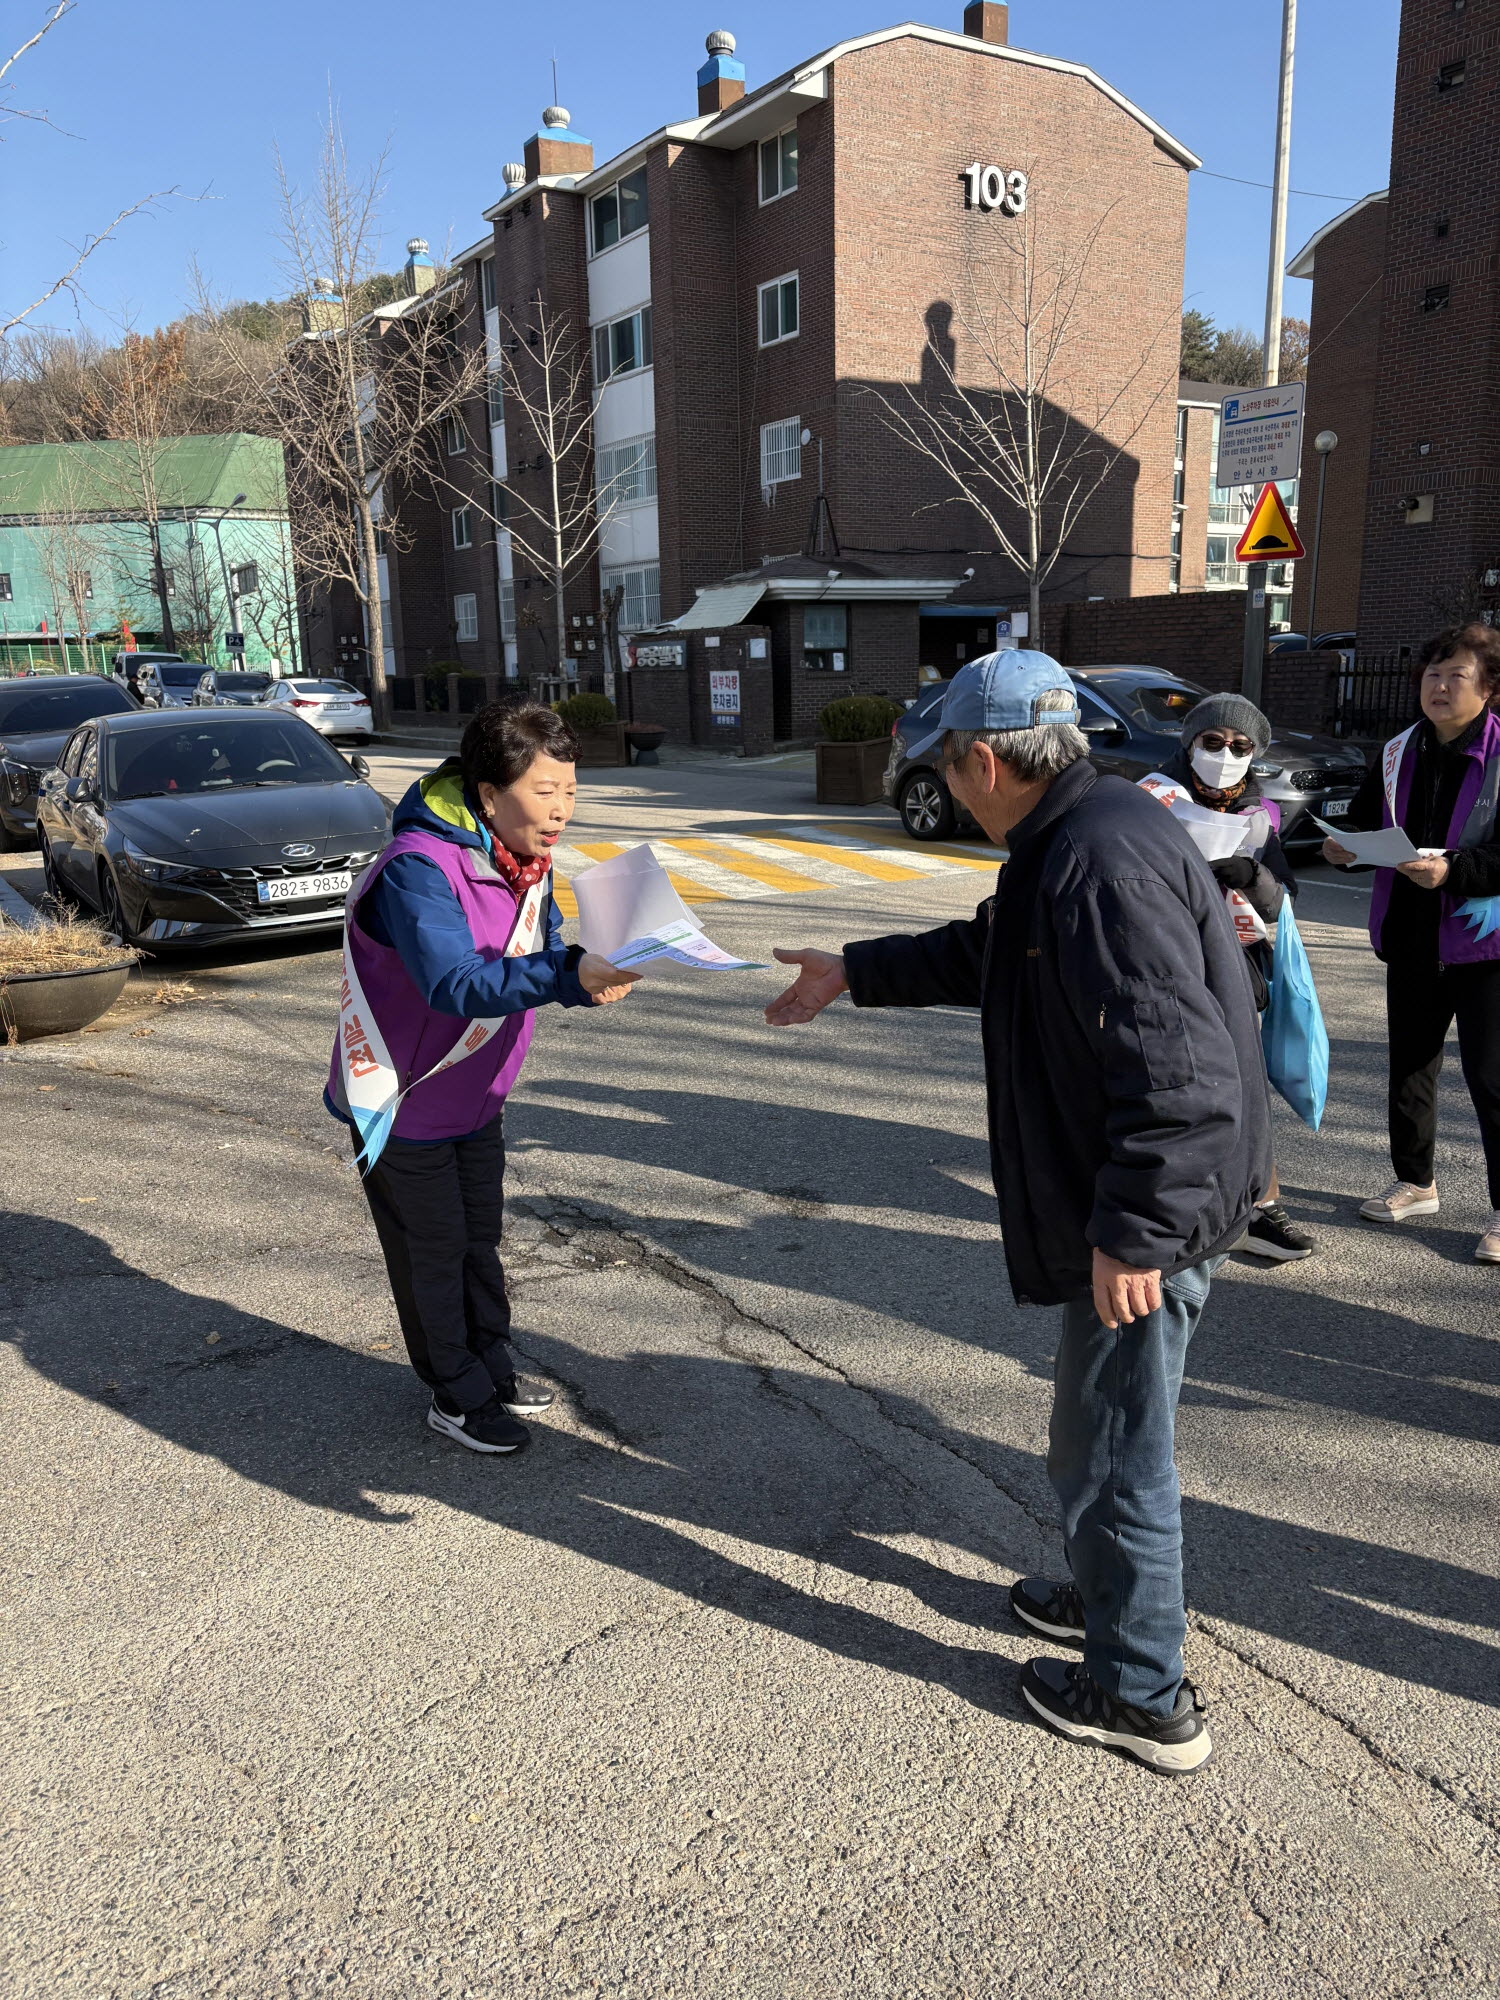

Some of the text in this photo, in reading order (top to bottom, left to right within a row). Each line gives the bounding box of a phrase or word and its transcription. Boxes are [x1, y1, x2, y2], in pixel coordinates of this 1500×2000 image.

[965, 162, 1028, 213] 103
[228, 636, 235, 646] P
[711, 675, 738, 690] 외부차량
[712, 693, 738, 709] 주차금지
[270, 875, 349, 898] 282주 9836
